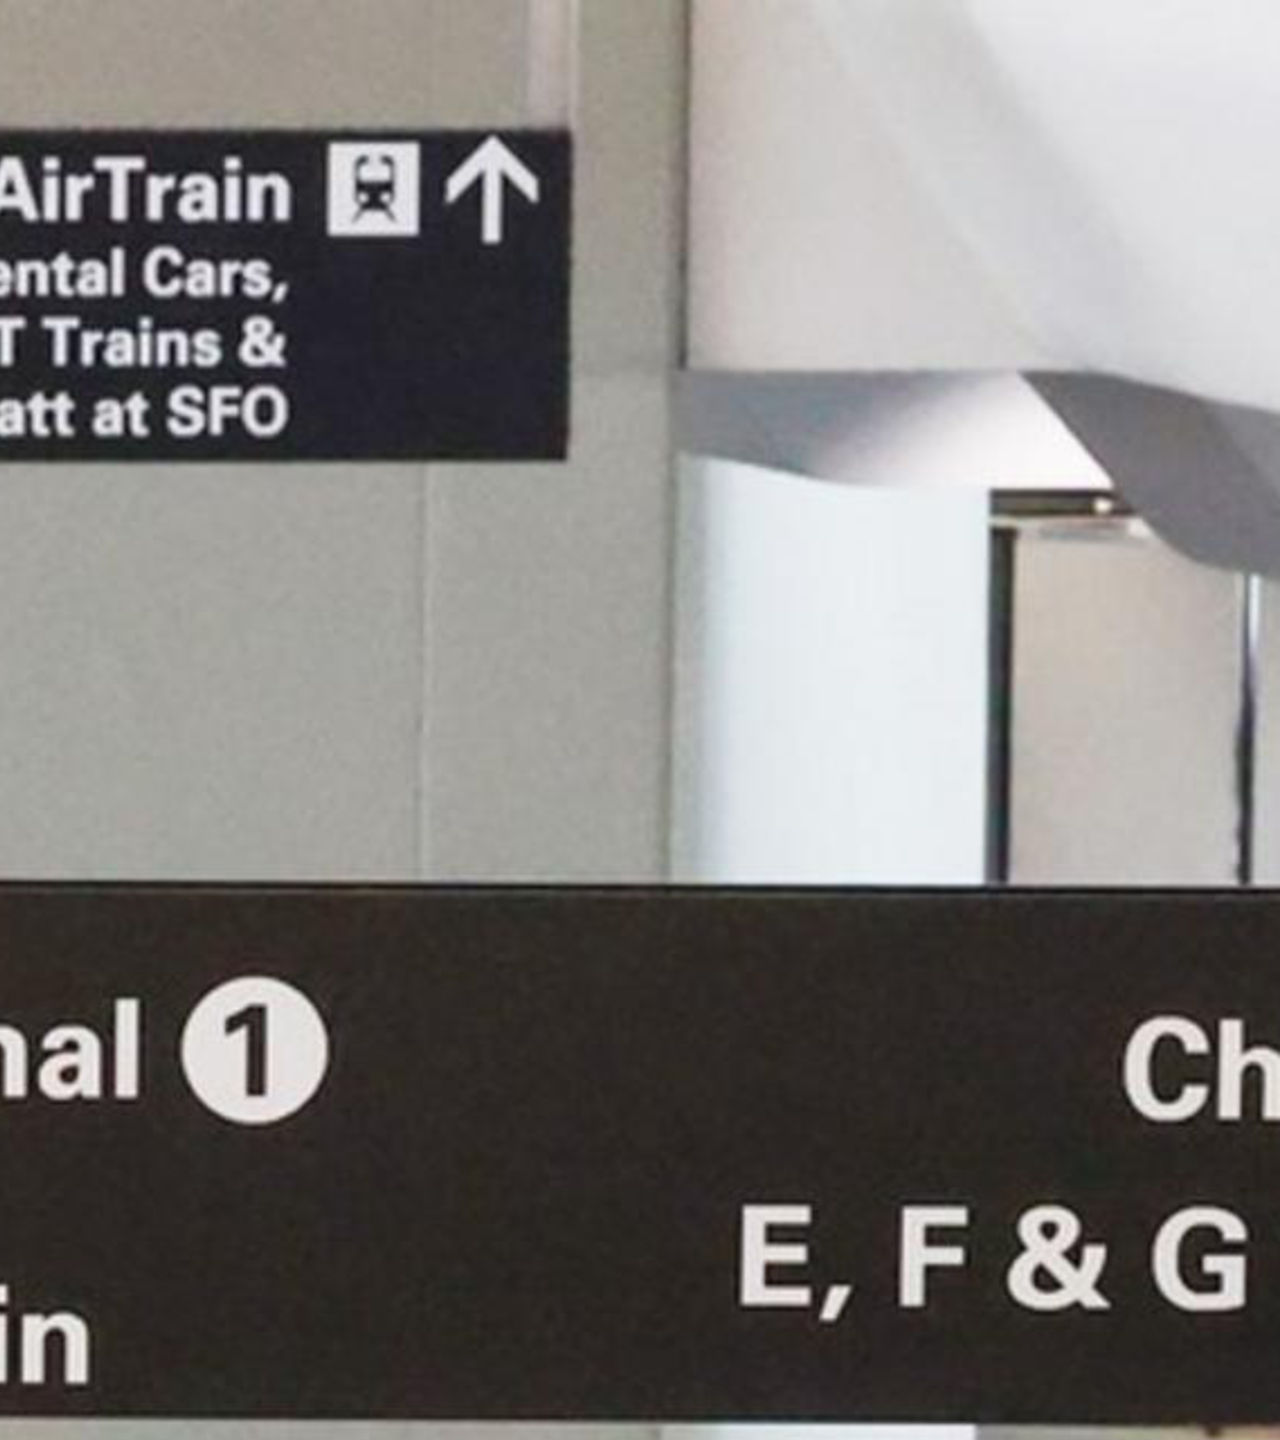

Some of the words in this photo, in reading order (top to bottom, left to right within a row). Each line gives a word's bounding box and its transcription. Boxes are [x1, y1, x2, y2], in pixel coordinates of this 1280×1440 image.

[143, 246, 287, 303] Cars,
[41, 316, 222, 367] Trains
[238, 315, 285, 367] &
[92, 392, 149, 437] at
[167, 385, 288, 438] SFO
[1124, 1016, 1280, 1121] Ch
[741, 1205, 851, 1321] E,
[900, 1206, 968, 1307] F
[1007, 1205, 1110, 1310] &
[1153, 1206, 1247, 1311] G
